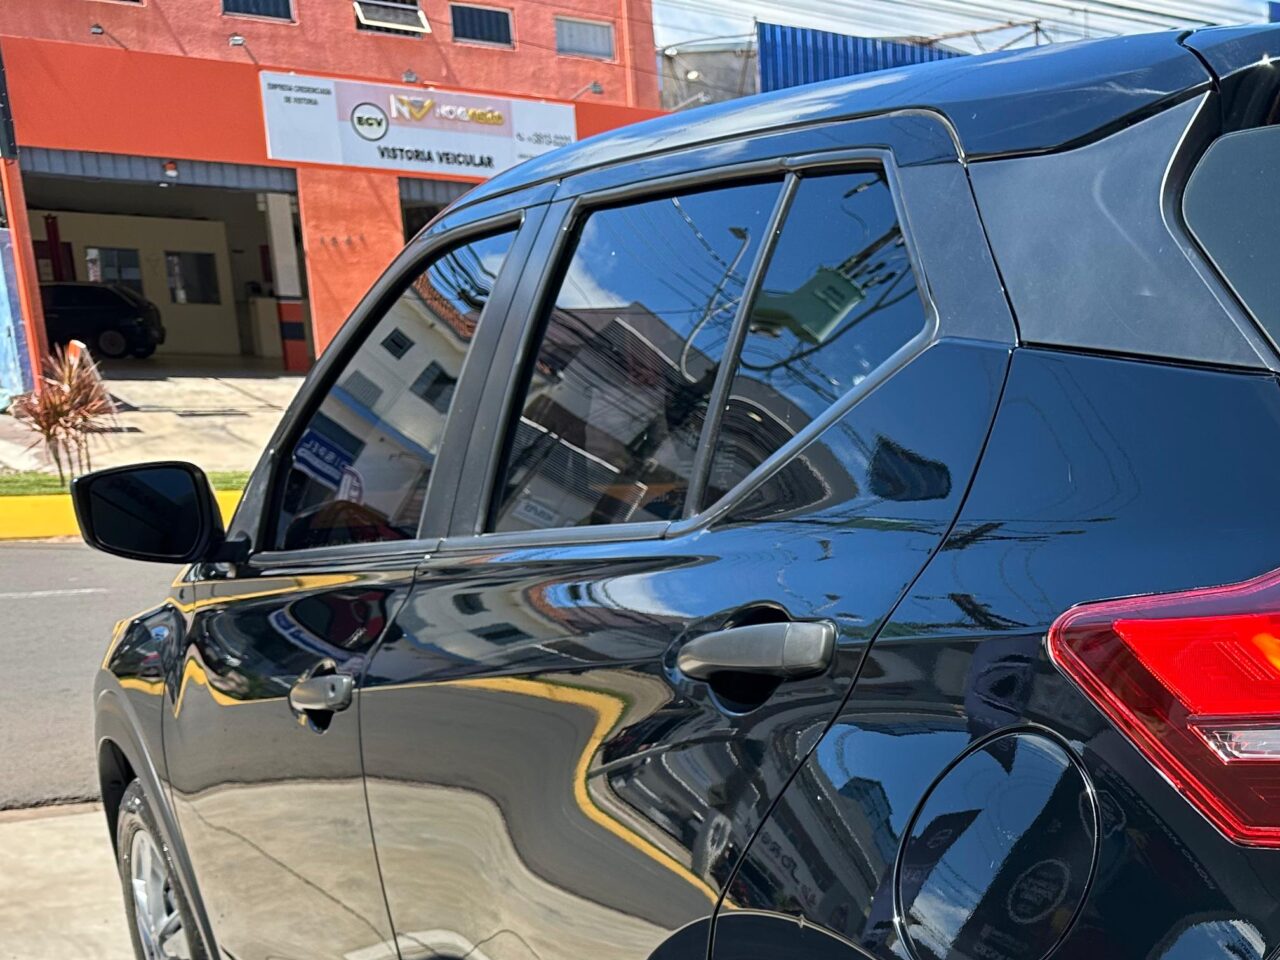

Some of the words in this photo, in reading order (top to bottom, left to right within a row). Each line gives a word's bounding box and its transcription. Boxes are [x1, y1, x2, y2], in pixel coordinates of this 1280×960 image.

[356, 116, 383, 128] ECV
[377, 146, 433, 164] VISTORIA
[437, 150, 494, 169] VEICULAR
